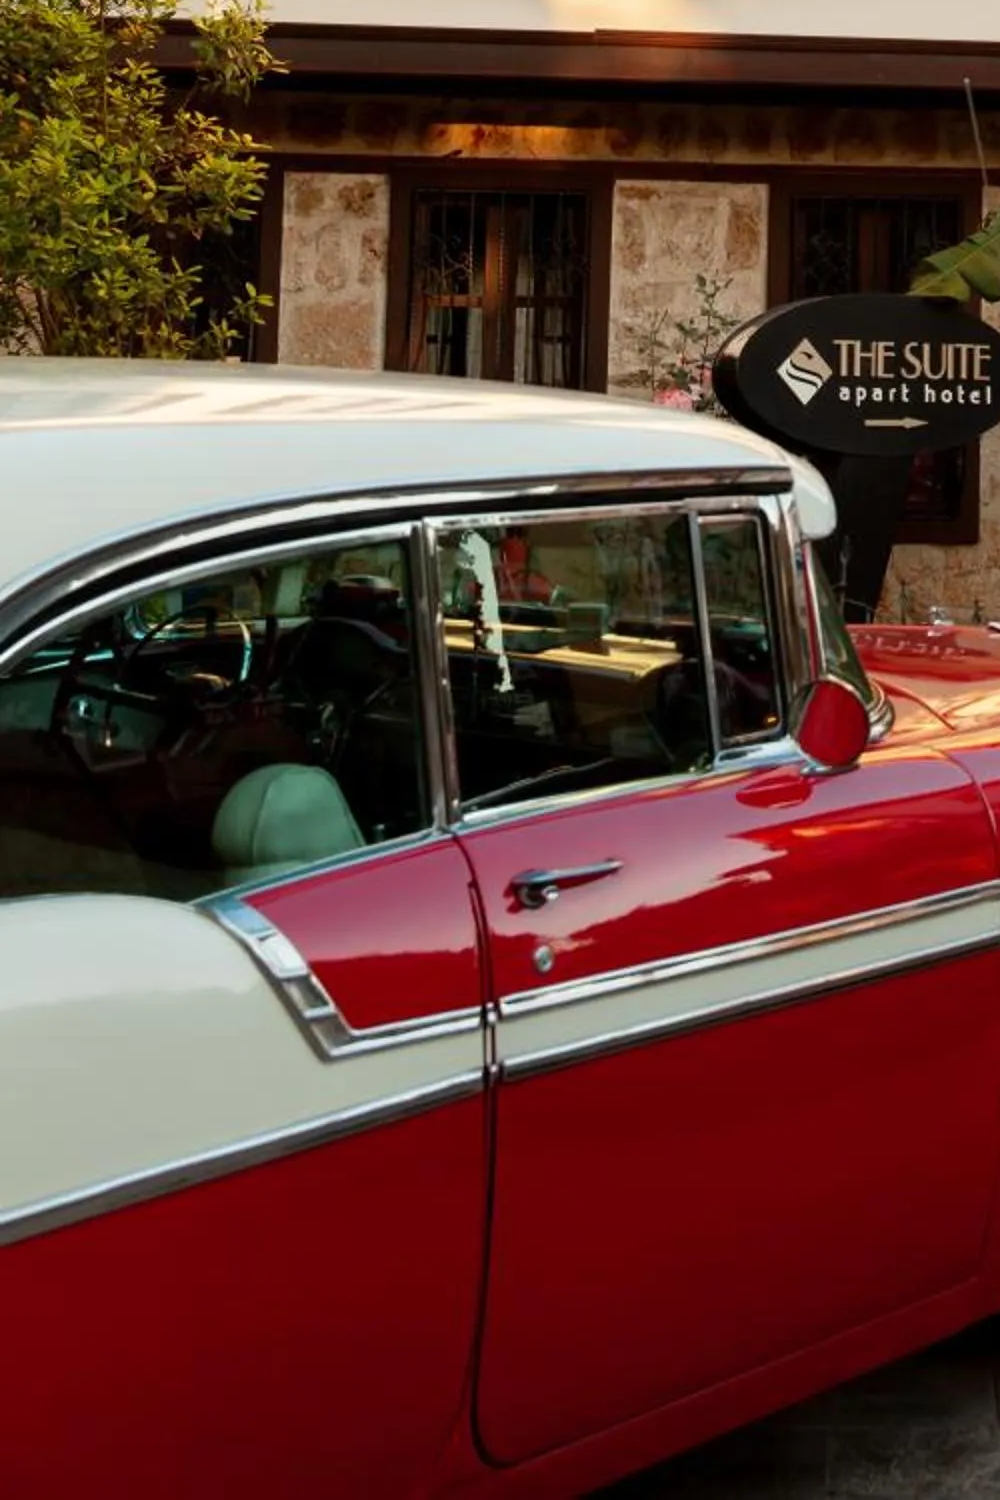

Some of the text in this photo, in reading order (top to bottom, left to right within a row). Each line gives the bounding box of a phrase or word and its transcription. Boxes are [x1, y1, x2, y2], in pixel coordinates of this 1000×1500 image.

[833, 339, 992, 381] THE SUITE
[839, 383, 992, 407] apart hotel
